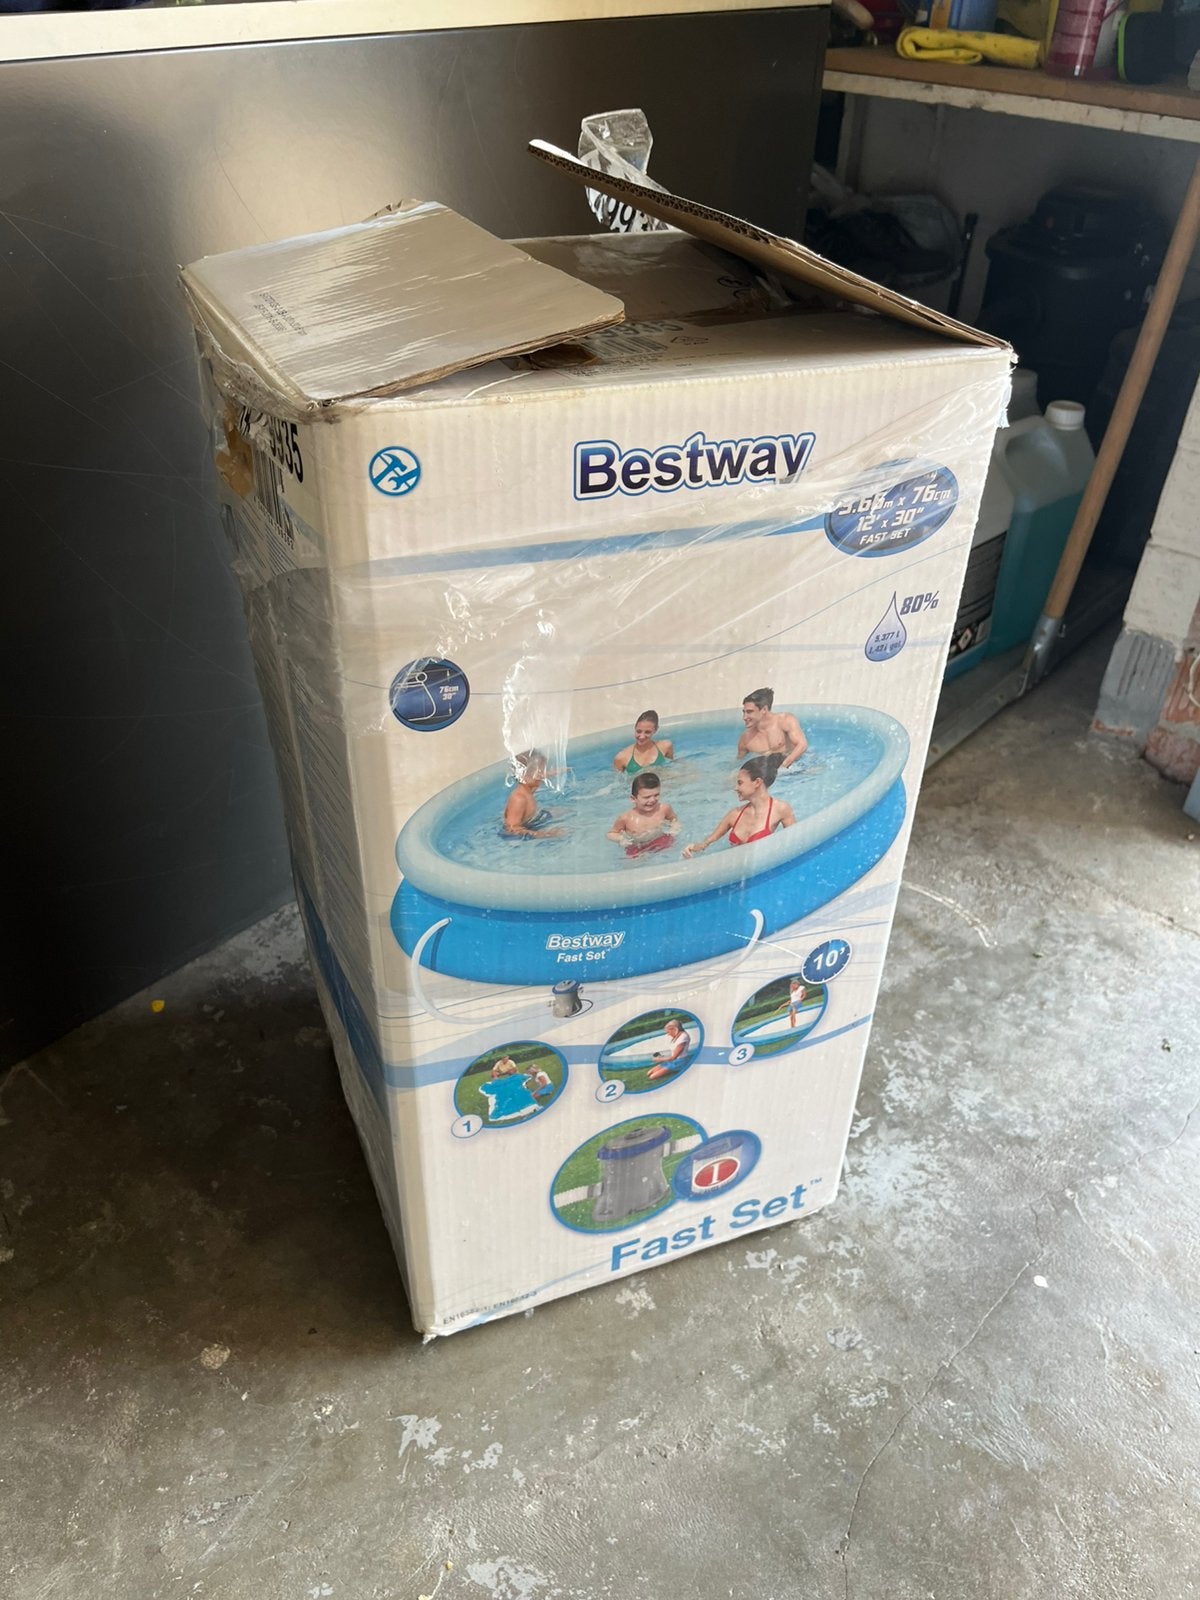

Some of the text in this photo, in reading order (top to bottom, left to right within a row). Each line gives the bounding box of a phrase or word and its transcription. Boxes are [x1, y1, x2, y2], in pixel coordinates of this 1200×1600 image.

[576, 433, 814, 499] Bestway
[859, 528, 911, 545] FAST SET
[899, 590, 940, 616] 80%
[546, 931, 626, 951] Bestway
[557, 950, 607, 963] Fast Set
[736, 1047, 748, 1060] 3
[604, 1084, 618, 1098] 2
[461, 1120, 472, 1133] 1
[610, 1215, 716, 1272] Fast
